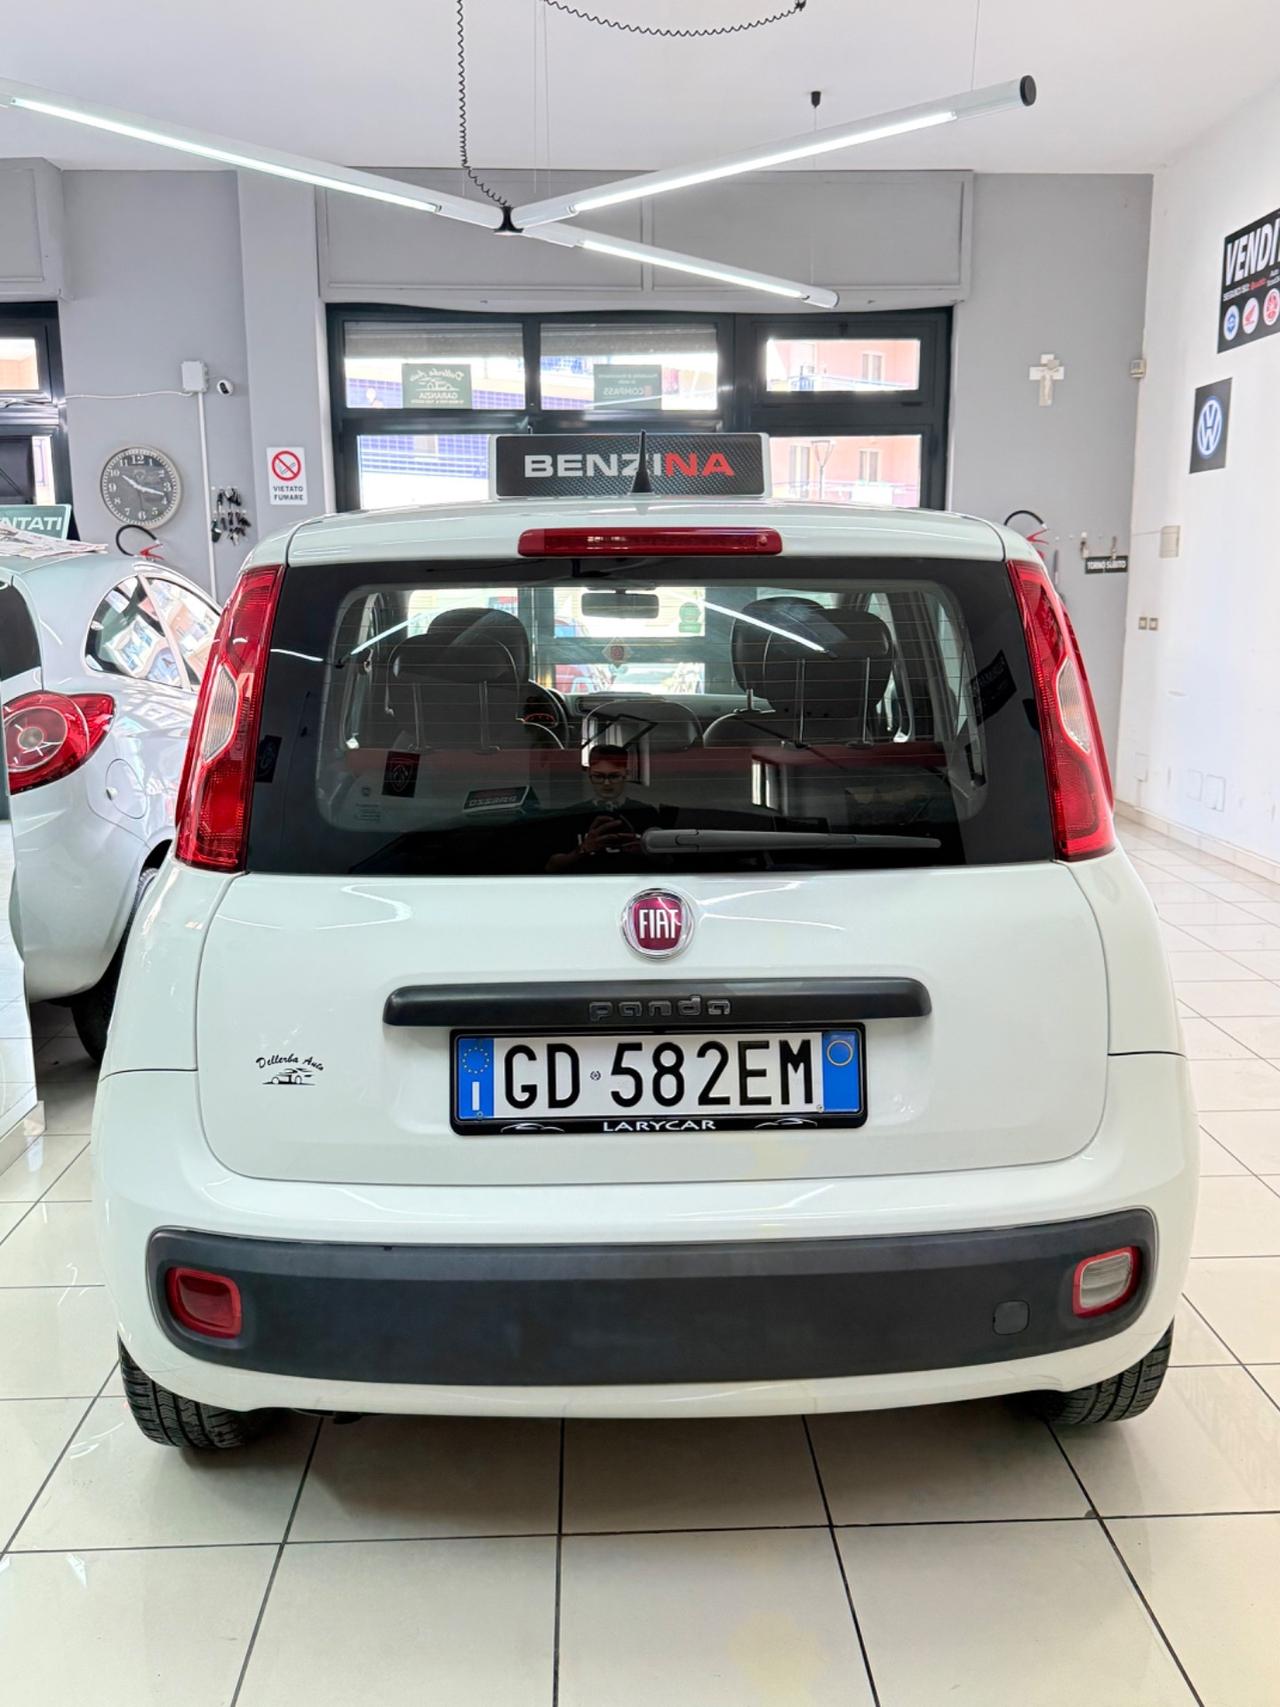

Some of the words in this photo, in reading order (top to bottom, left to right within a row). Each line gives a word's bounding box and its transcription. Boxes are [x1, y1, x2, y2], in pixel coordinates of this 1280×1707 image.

[1226, 218, 1280, 286] VENDI
[131, 455, 145, 465] 12
[110, 468, 120, 477] 10
[108, 482, 117, 492] 9
[163, 482, 172, 493] 3
[124, 507, 131, 516] 7
[138, 511, 147, 521] 6
[639, 909, 679, 939] FIAT
[588, 994, 732, 1022] panda
[255, 1053, 299, 1069] Dellerba
[302, 1056, 325, 1071] Auto
[504, 1043, 580, 1110] GD
[610, 1039, 814, 1108] 582EM
[602, 1119, 717, 1133] LARYCAR
